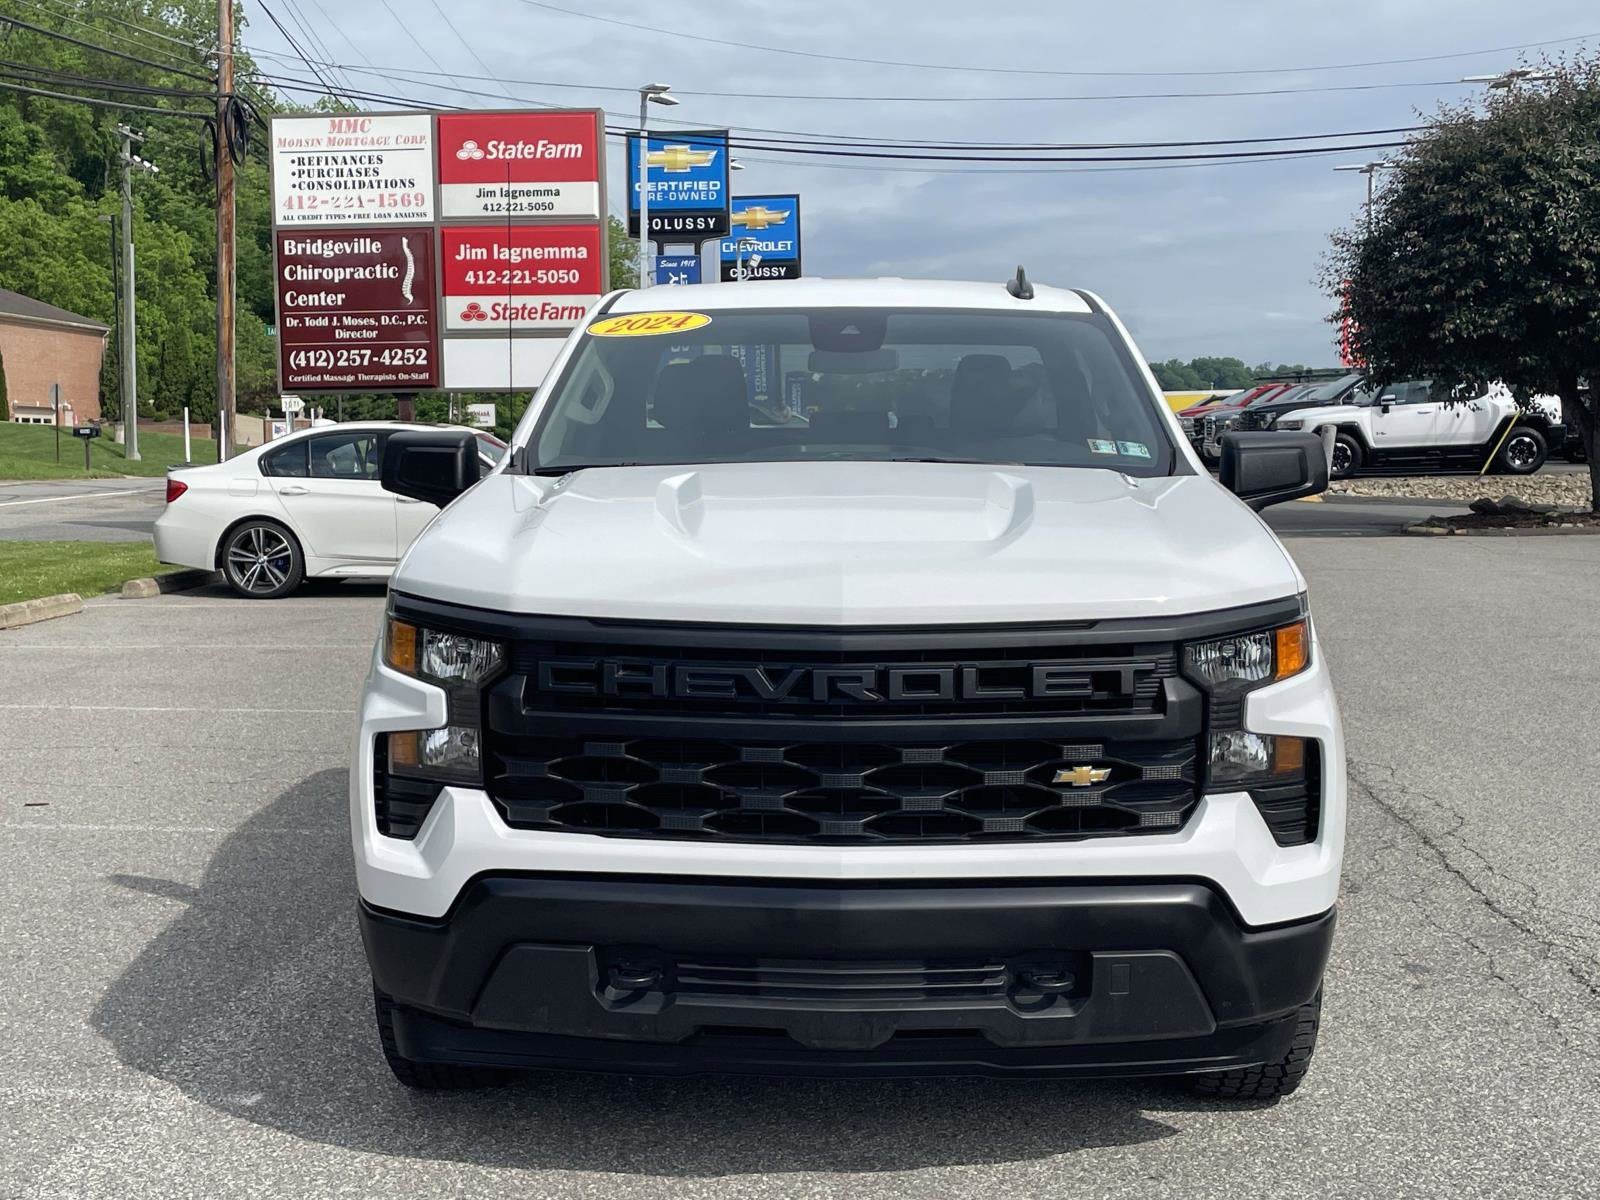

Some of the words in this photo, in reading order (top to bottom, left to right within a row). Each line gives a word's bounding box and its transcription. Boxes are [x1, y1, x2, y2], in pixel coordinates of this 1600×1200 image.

[328, 118, 372, 134] MMC
[326, 136, 390, 147] MORTGAGE
[396, 134, 427, 145] CORP.
[297, 155, 384, 166] REFINANCES
[298, 167, 380, 178] PURCHASES
[299, 179, 416, 190] CONSOLIDATIONS
[476, 188, 496, 199] Jim
[500, 187, 561, 200] Iagnemma
[648, 191, 718, 201] RE-OWNED
[283, 192, 426, 210] 412-221-1569
[482, 202, 554, 212] 412-221-5050
[646, 217, 716, 230] OLUSSY
[284, 238, 382, 258] Bridgeville
[722, 240, 794, 253] CHEVROLET
[455, 244, 488, 260] Jim
[493, 243, 588, 264] Iagnemma
[659, 260, 678, 268] Since
[680, 259, 696, 268] 1918
[284, 263, 399, 283] Chiropractic
[464, 269, 580, 285] 412-221-5050
[284, 291, 346, 307] Center
[286, 317, 302, 327] Dr.
[304, 317, 329, 327] Todd
[332, 316, 340, 327] J.
[342, 316, 379, 327] Moses,
[381, 315, 406, 326] D.C.,
[407, 315, 428, 325] P.C.
[605, 315, 694, 333] 2024
[335, 329, 379, 339] Director
[289, 350, 335, 370] (412)
[337, 348, 428, 366] 257-4252
[289, 374, 321, 382] Certified
[323, 374, 356, 383] Massage
[358, 373, 396, 382] Therapists
[538, 659, 1157, 702] CHEVROLET
